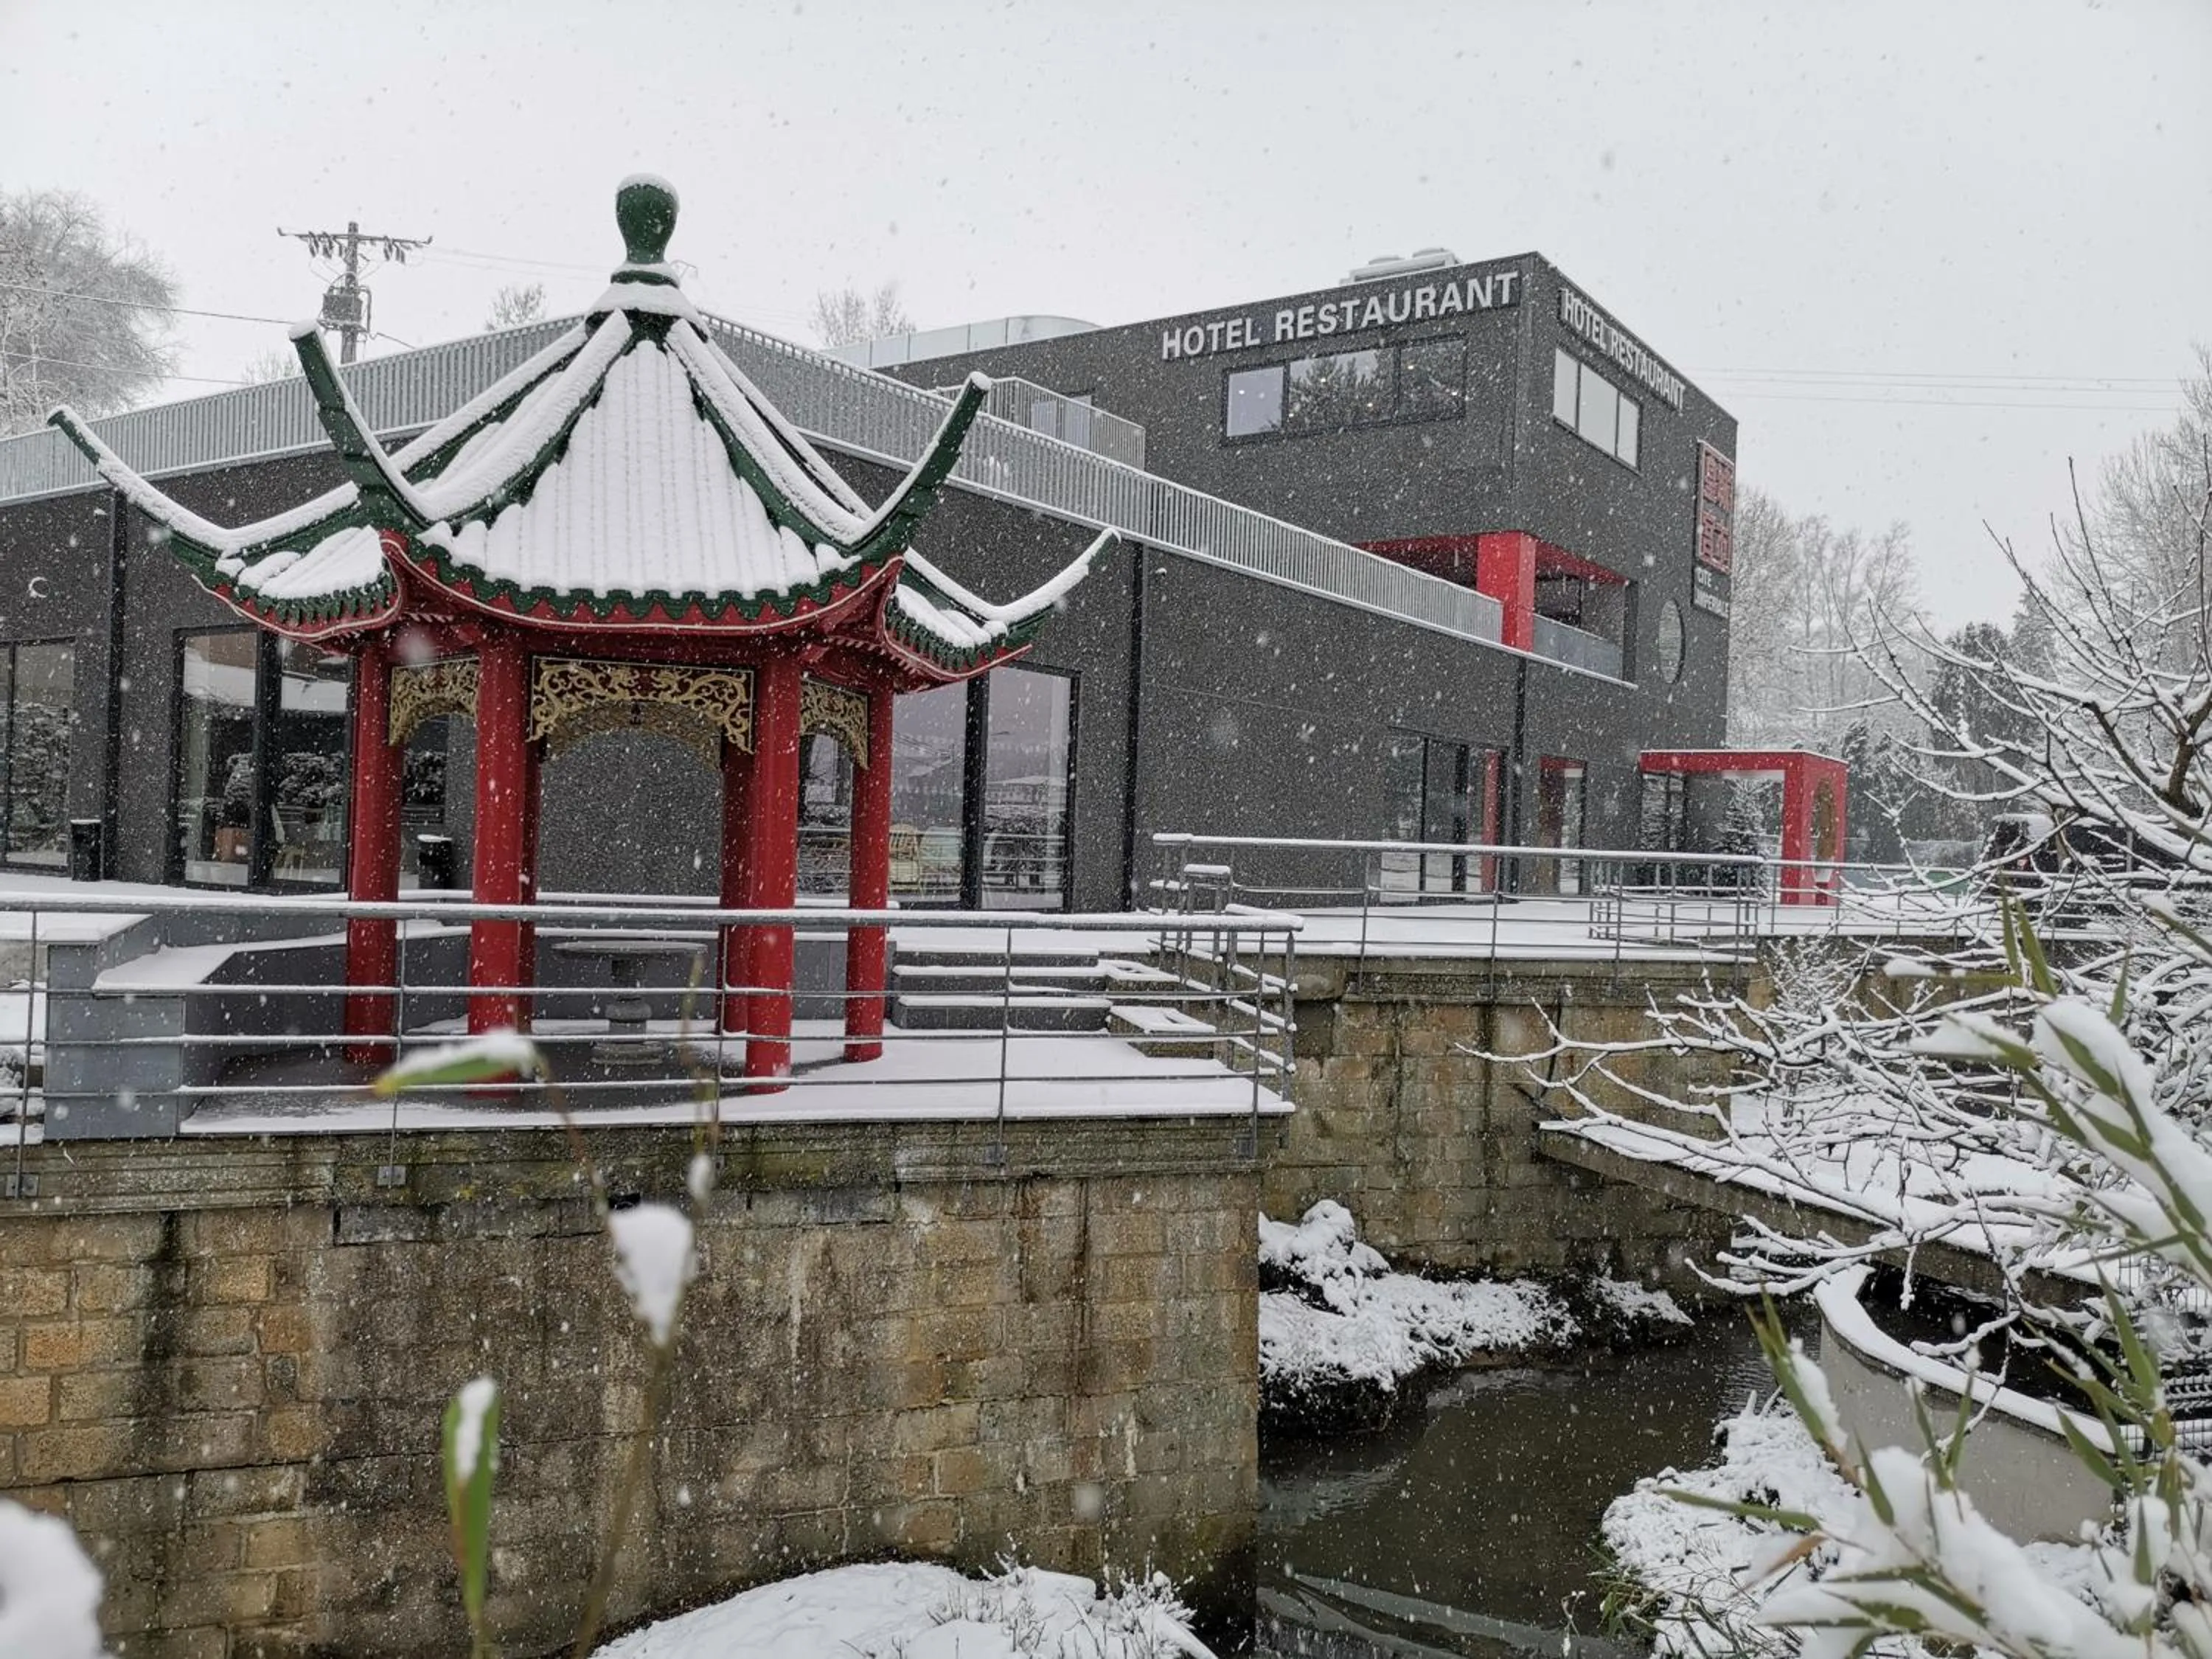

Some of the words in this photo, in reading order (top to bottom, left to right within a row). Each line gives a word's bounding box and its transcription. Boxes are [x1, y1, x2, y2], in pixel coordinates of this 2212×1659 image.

[1161, 317, 1261, 360] HOTEL
[1275, 271, 1519, 341] RESTAURANT
[1562, 288, 1606, 351] HOTEL
[1608, 327, 1686, 411] RESTAURANT
